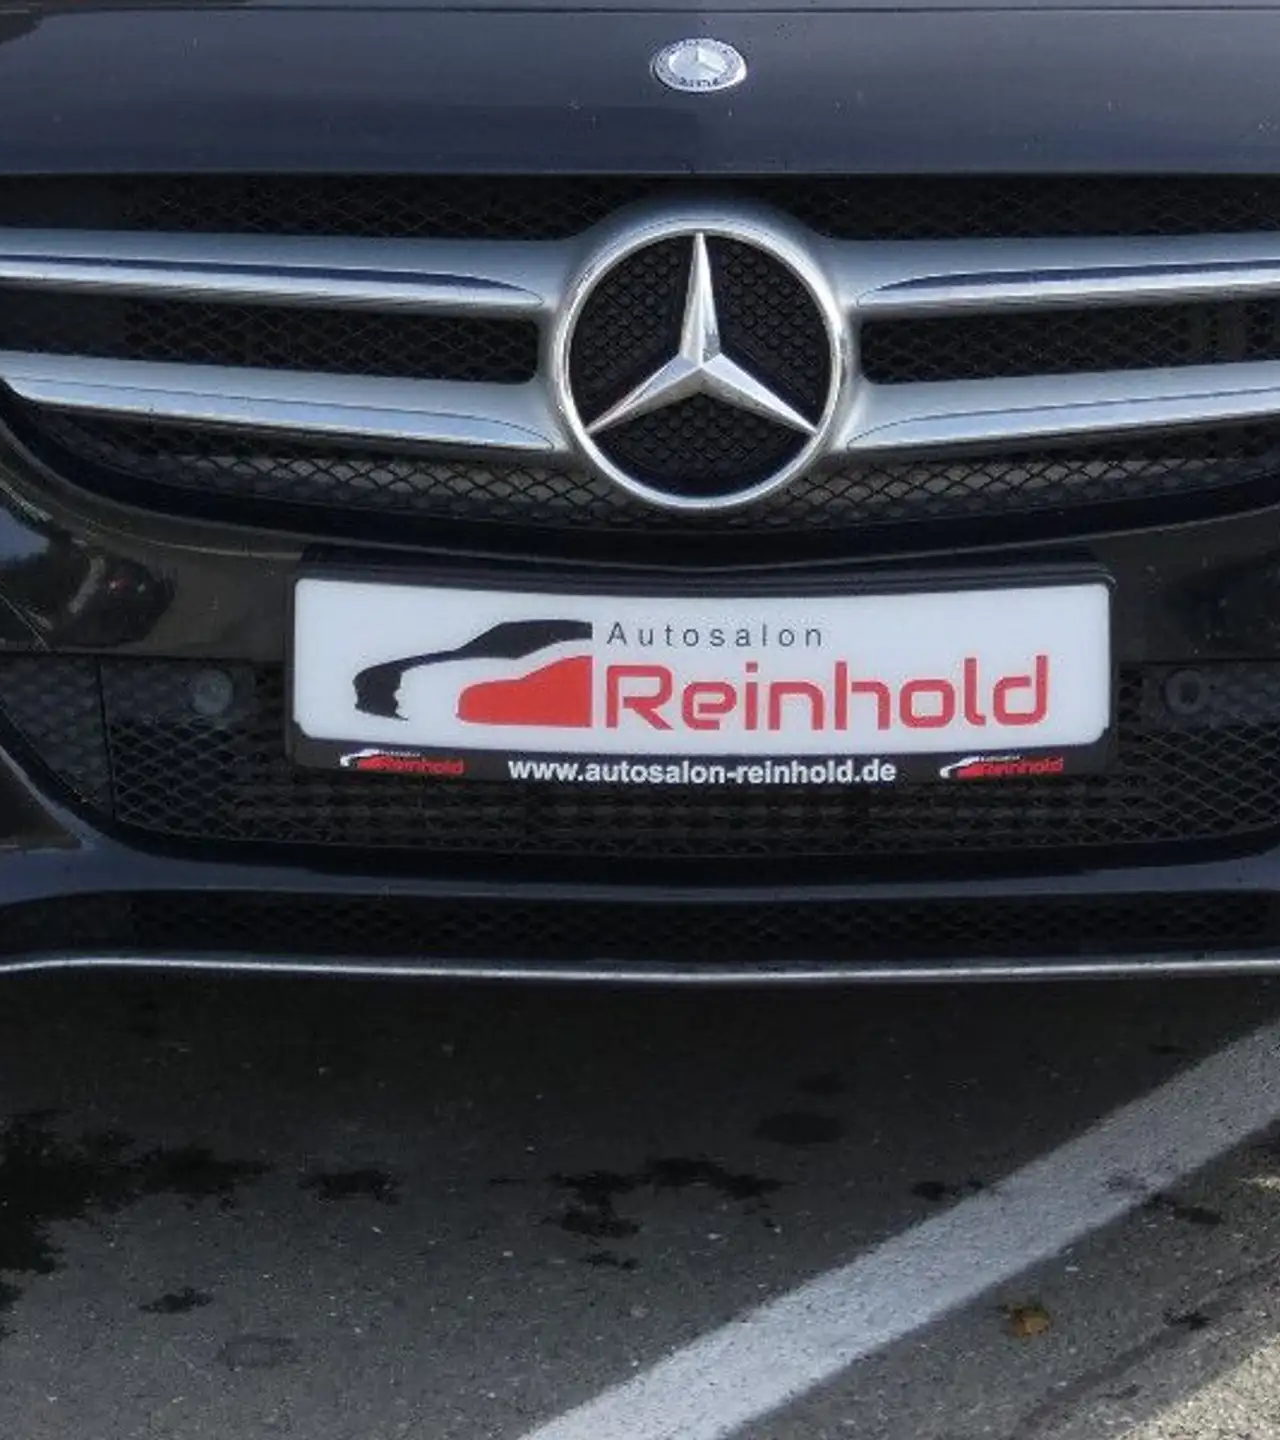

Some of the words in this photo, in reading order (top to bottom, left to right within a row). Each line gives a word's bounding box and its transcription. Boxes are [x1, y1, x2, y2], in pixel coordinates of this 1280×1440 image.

[606, 621, 823, 648] Autosalon
[605, 654, 1050, 731] Reinhold
[507, 758, 897, 784] www.autosalon-reinhold.de
